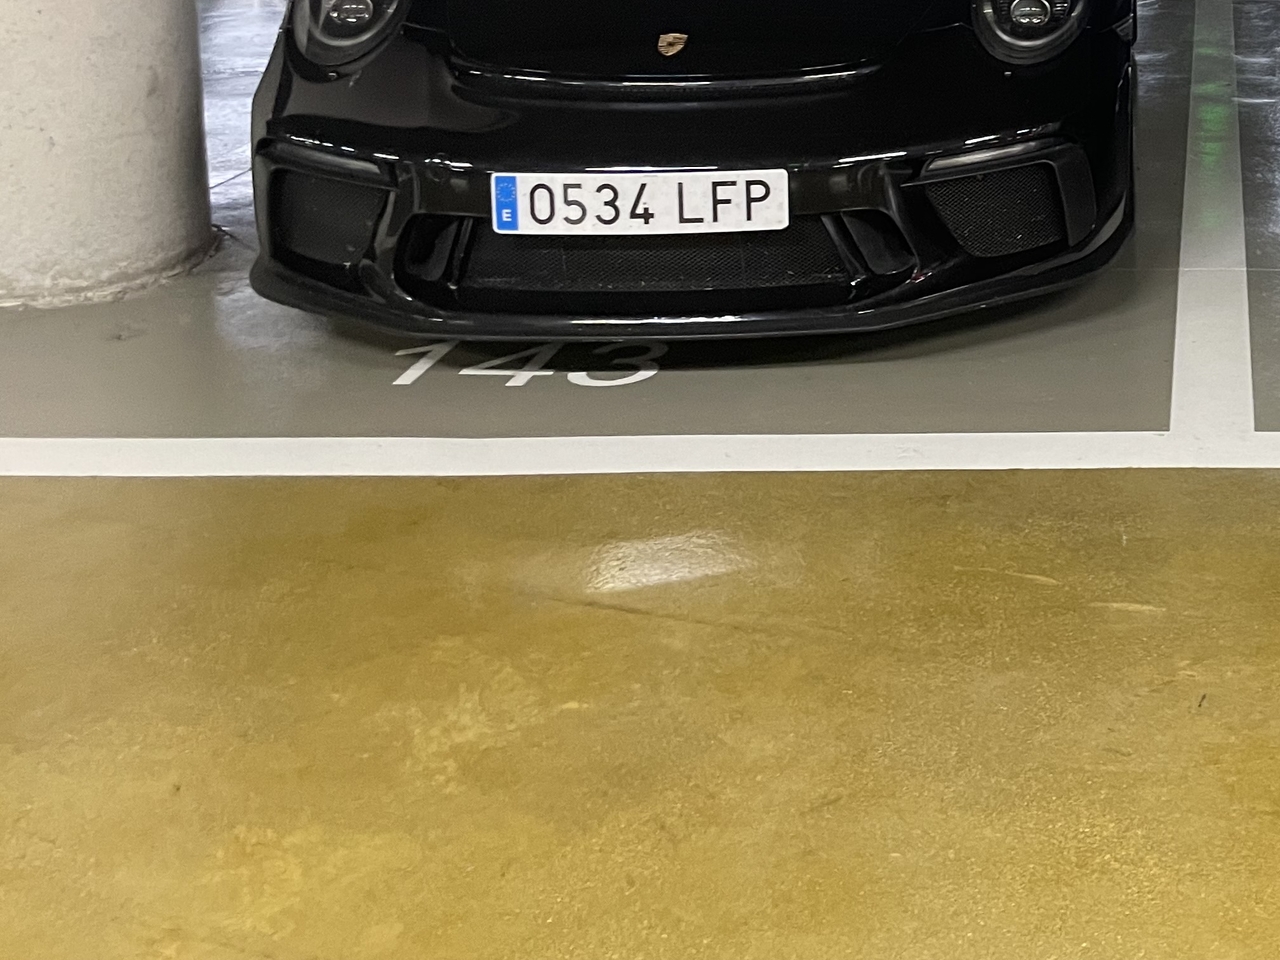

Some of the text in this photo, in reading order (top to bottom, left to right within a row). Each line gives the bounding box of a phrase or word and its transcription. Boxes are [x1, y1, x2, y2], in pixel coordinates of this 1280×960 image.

[502, 179, 771, 225] E 0534 LFP
[392, 339, 668, 387] 143
